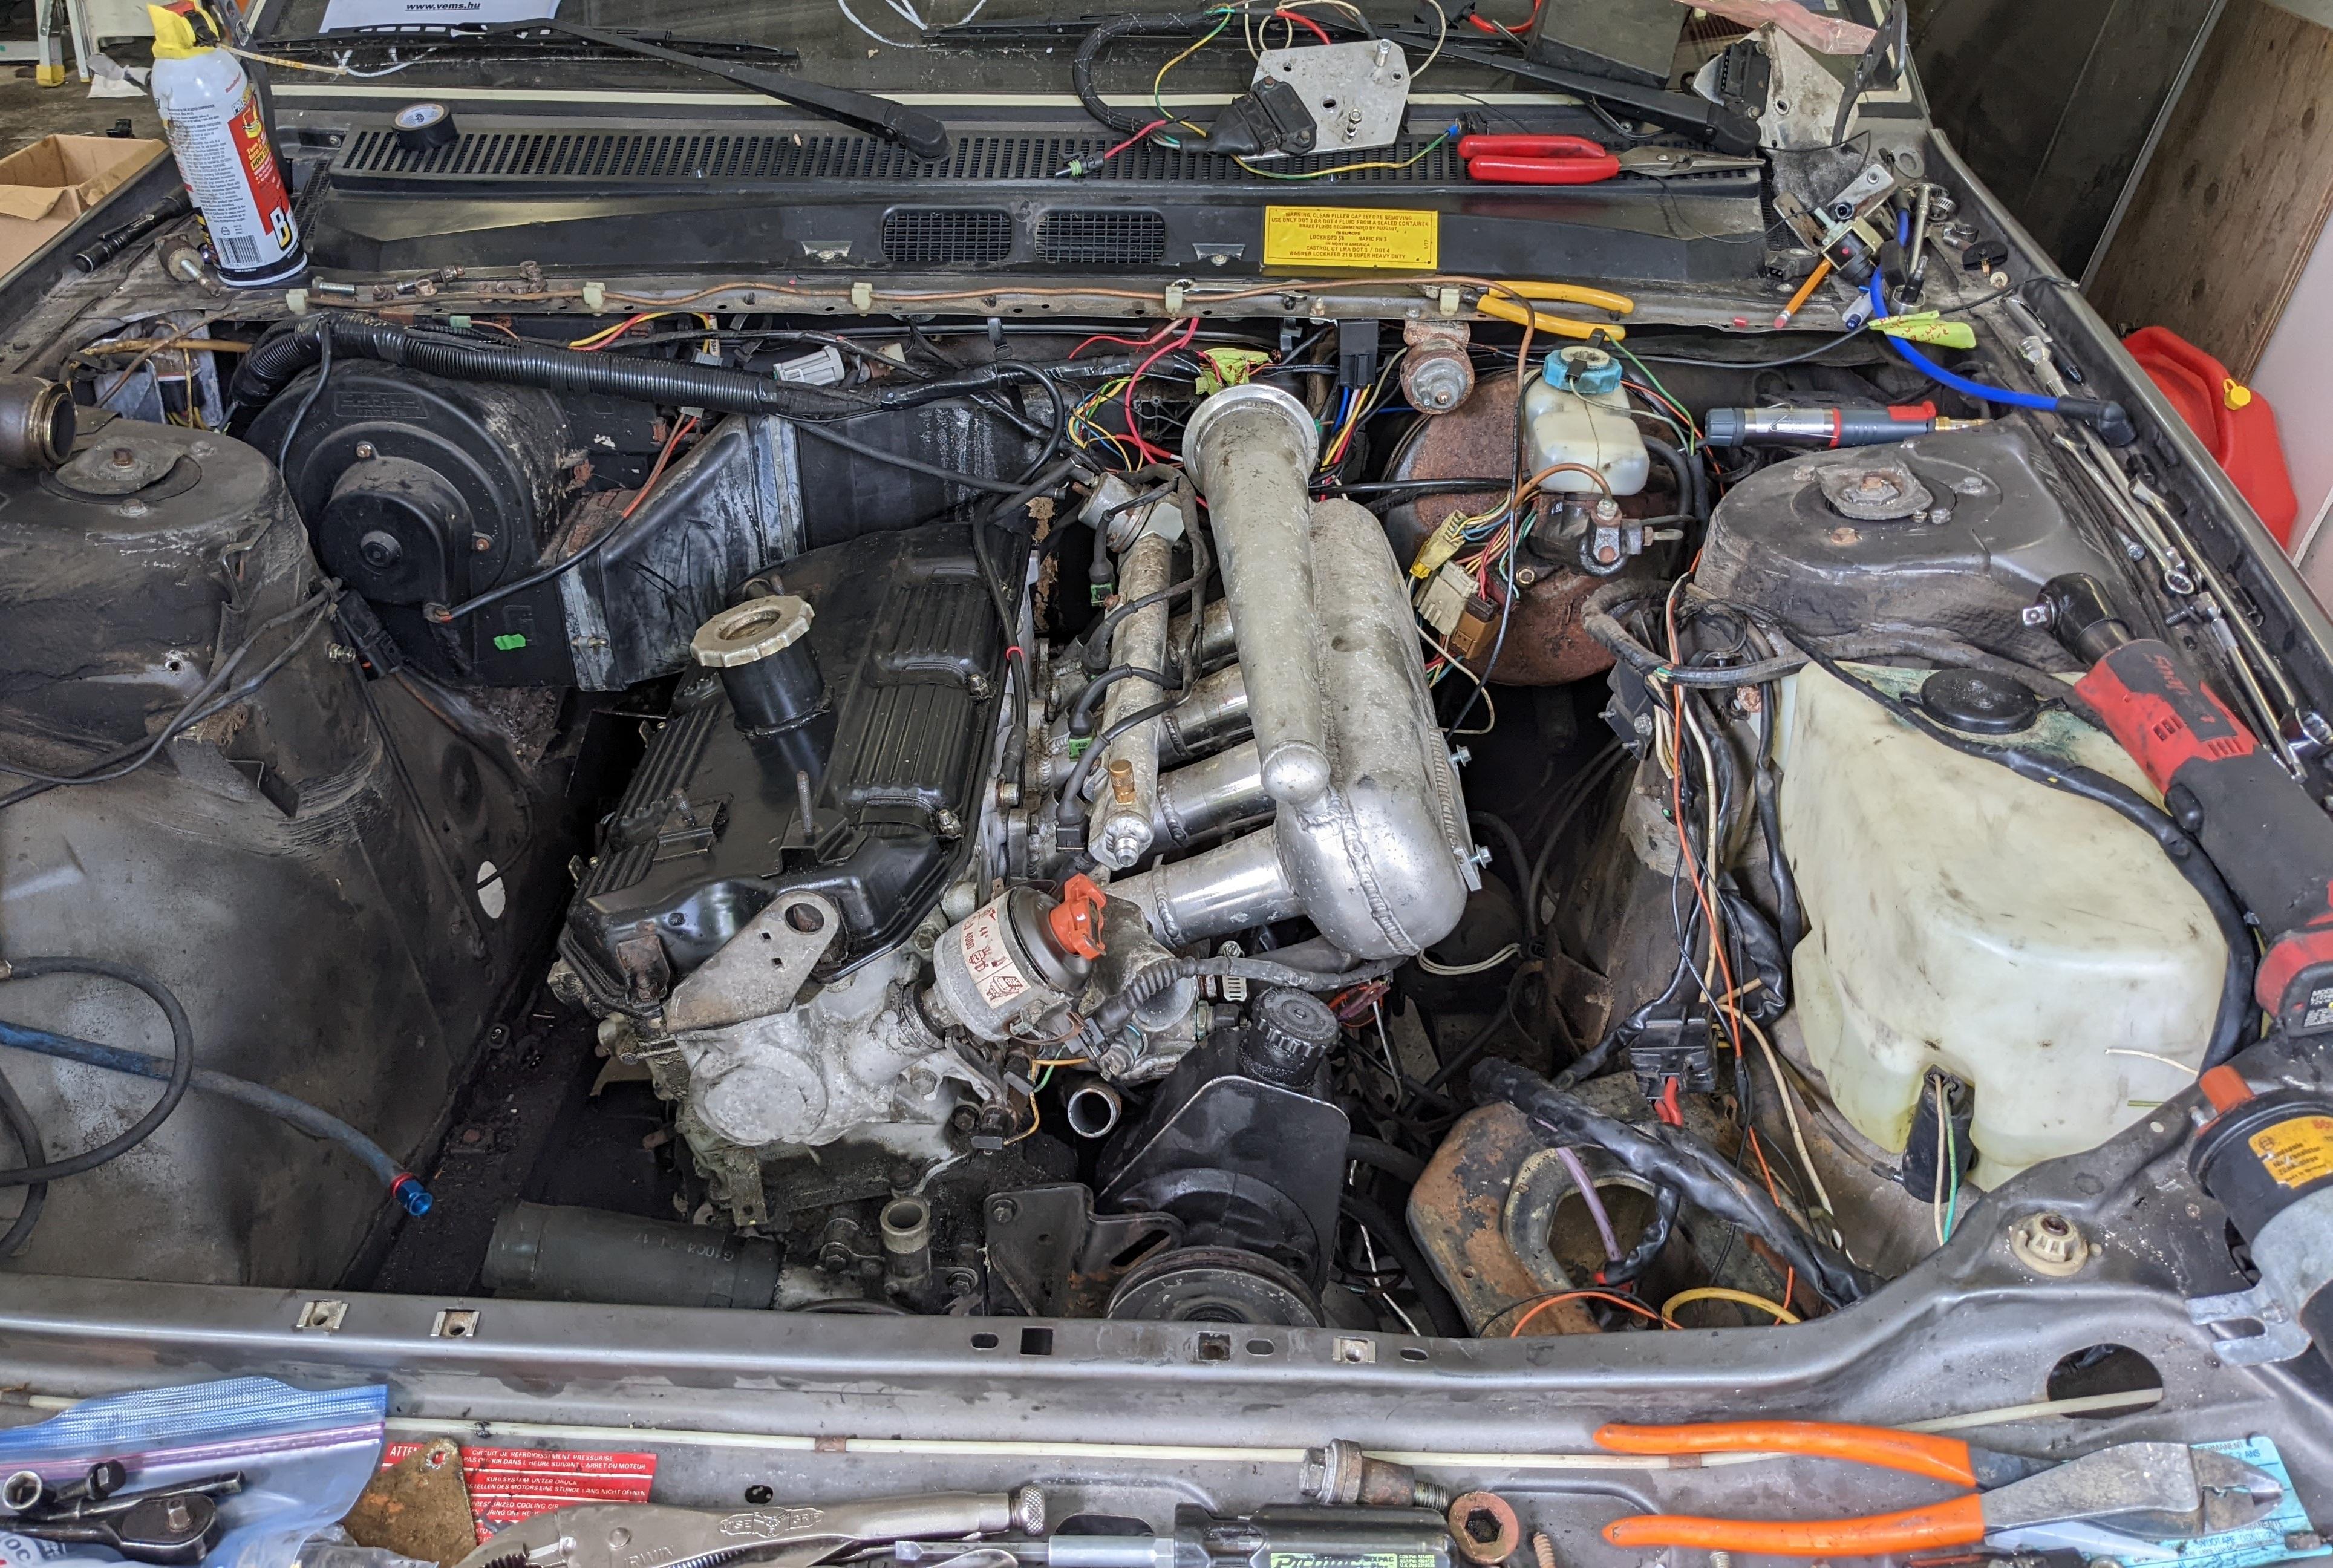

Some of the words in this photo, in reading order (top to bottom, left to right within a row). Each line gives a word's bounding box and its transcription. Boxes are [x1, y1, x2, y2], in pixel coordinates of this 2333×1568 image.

[405, 2, 480, 10] www.vems.hu
[252, 154, 264, 168] HOW
[965, 932, 974, 950] 4000
[2245, 1449, 2260, 1459] ANS
[720, 1519, 752, 1530] VISE
[792, 1512, 821, 1523] GRIP
